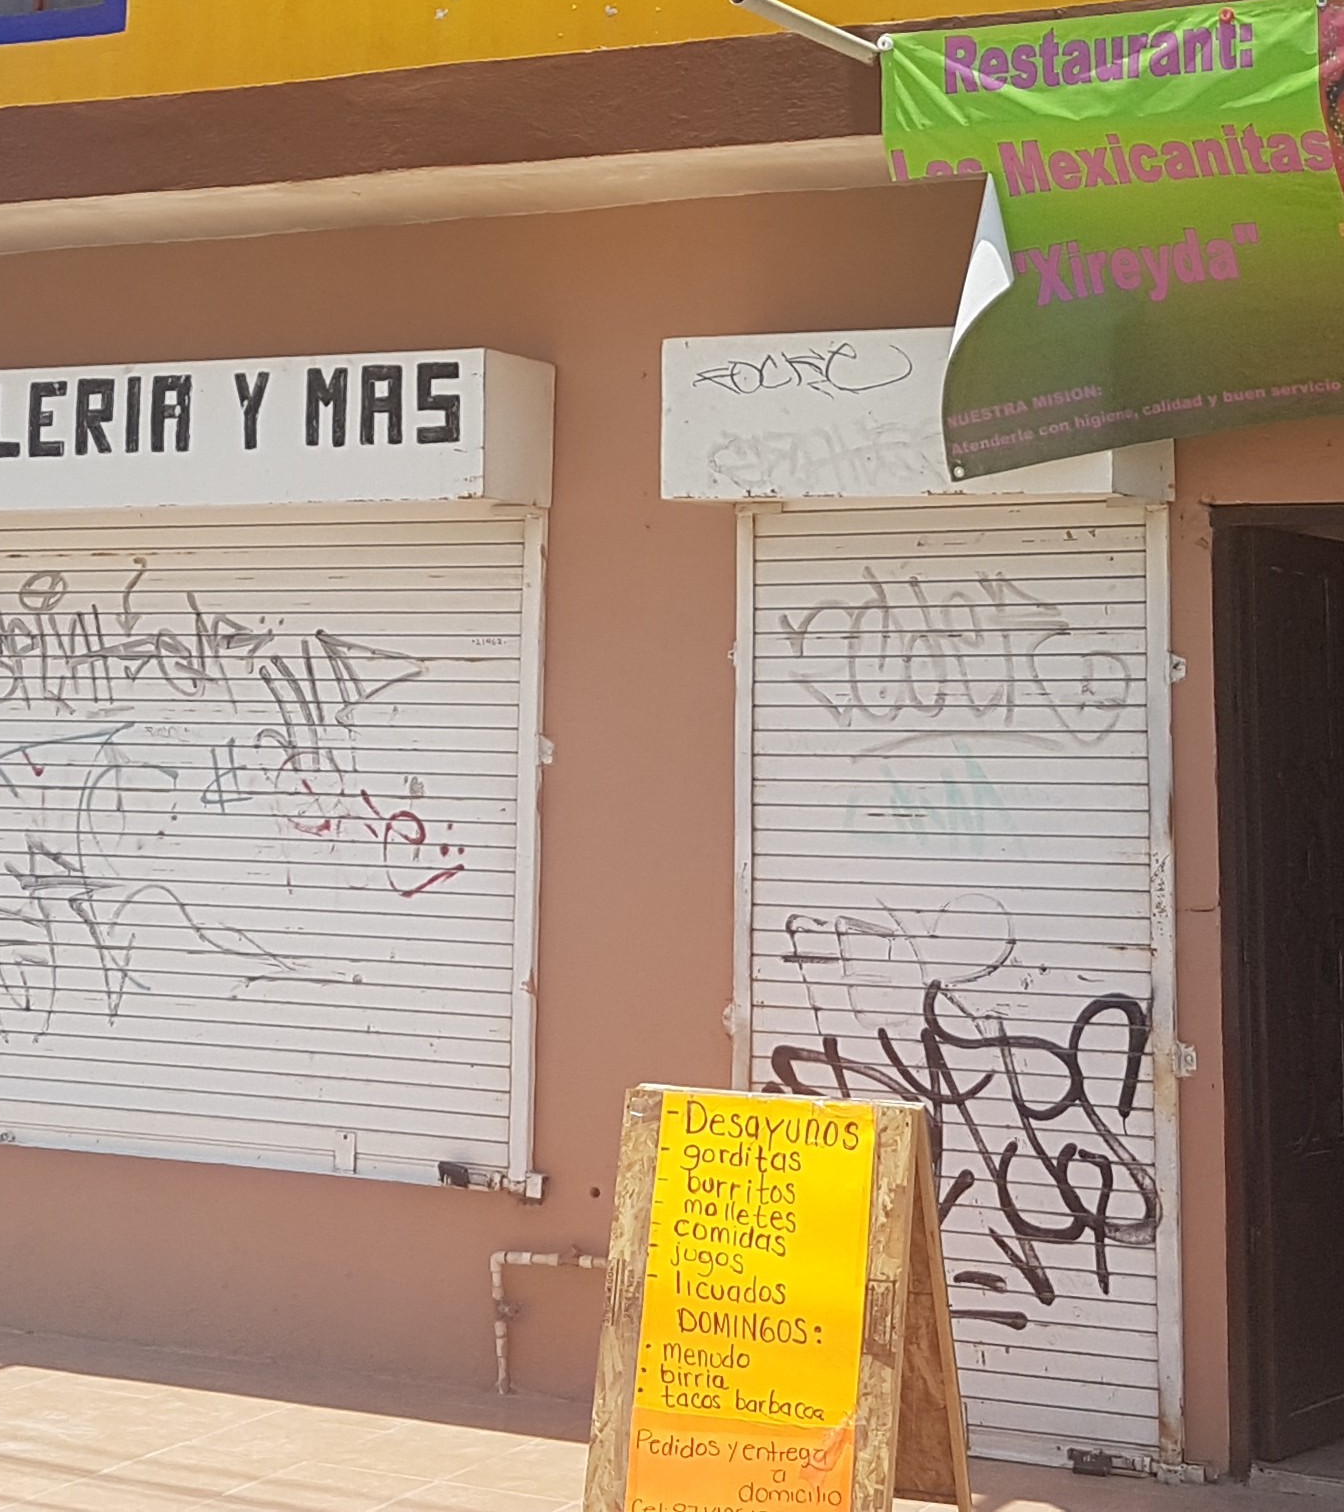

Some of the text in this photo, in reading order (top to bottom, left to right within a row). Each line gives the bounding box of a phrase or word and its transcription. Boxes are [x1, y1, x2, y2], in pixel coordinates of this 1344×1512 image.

[944, 22, 1254, 95] Restaurant:
[997, 123, 1334, 197] Mexicanitas
[234, 371, 270, 450] Y
[305, 361, 460, 448] MAS
[946, 399, 1029, 429] NUESTRA
[1039, 420, 1070, 437] con
[1074, 407, 1140, 432] higiene,
[1142, 392, 1203, 417] calidad
[1207, 393, 1218, 409] y
[1222, 384, 1267, 404] buen
[1270, 378, 1342, 399] servicio
[686, 1100, 860, 1151] Desayunos
[680, 1142, 801, 1173] gorditas
[687, 1170, 795, 1205] burritos
[684, 1199, 797, 1233] molletes
[674, 1219, 786, 1257] comidas
[670, 1242, 744, 1277] jugos
[676, 1270, 787, 1305] licuados
[663, 1342, 751, 1369] menudo
[660, 1363, 729, 1390] birria
[661, 1385, 825, 1422] tacos barbacoa
[636, 1428, 828, 1468] Pedidos y entrega
[772, 1469, 786, 1483] a
[738, 1483, 843, 1506] domicilio
